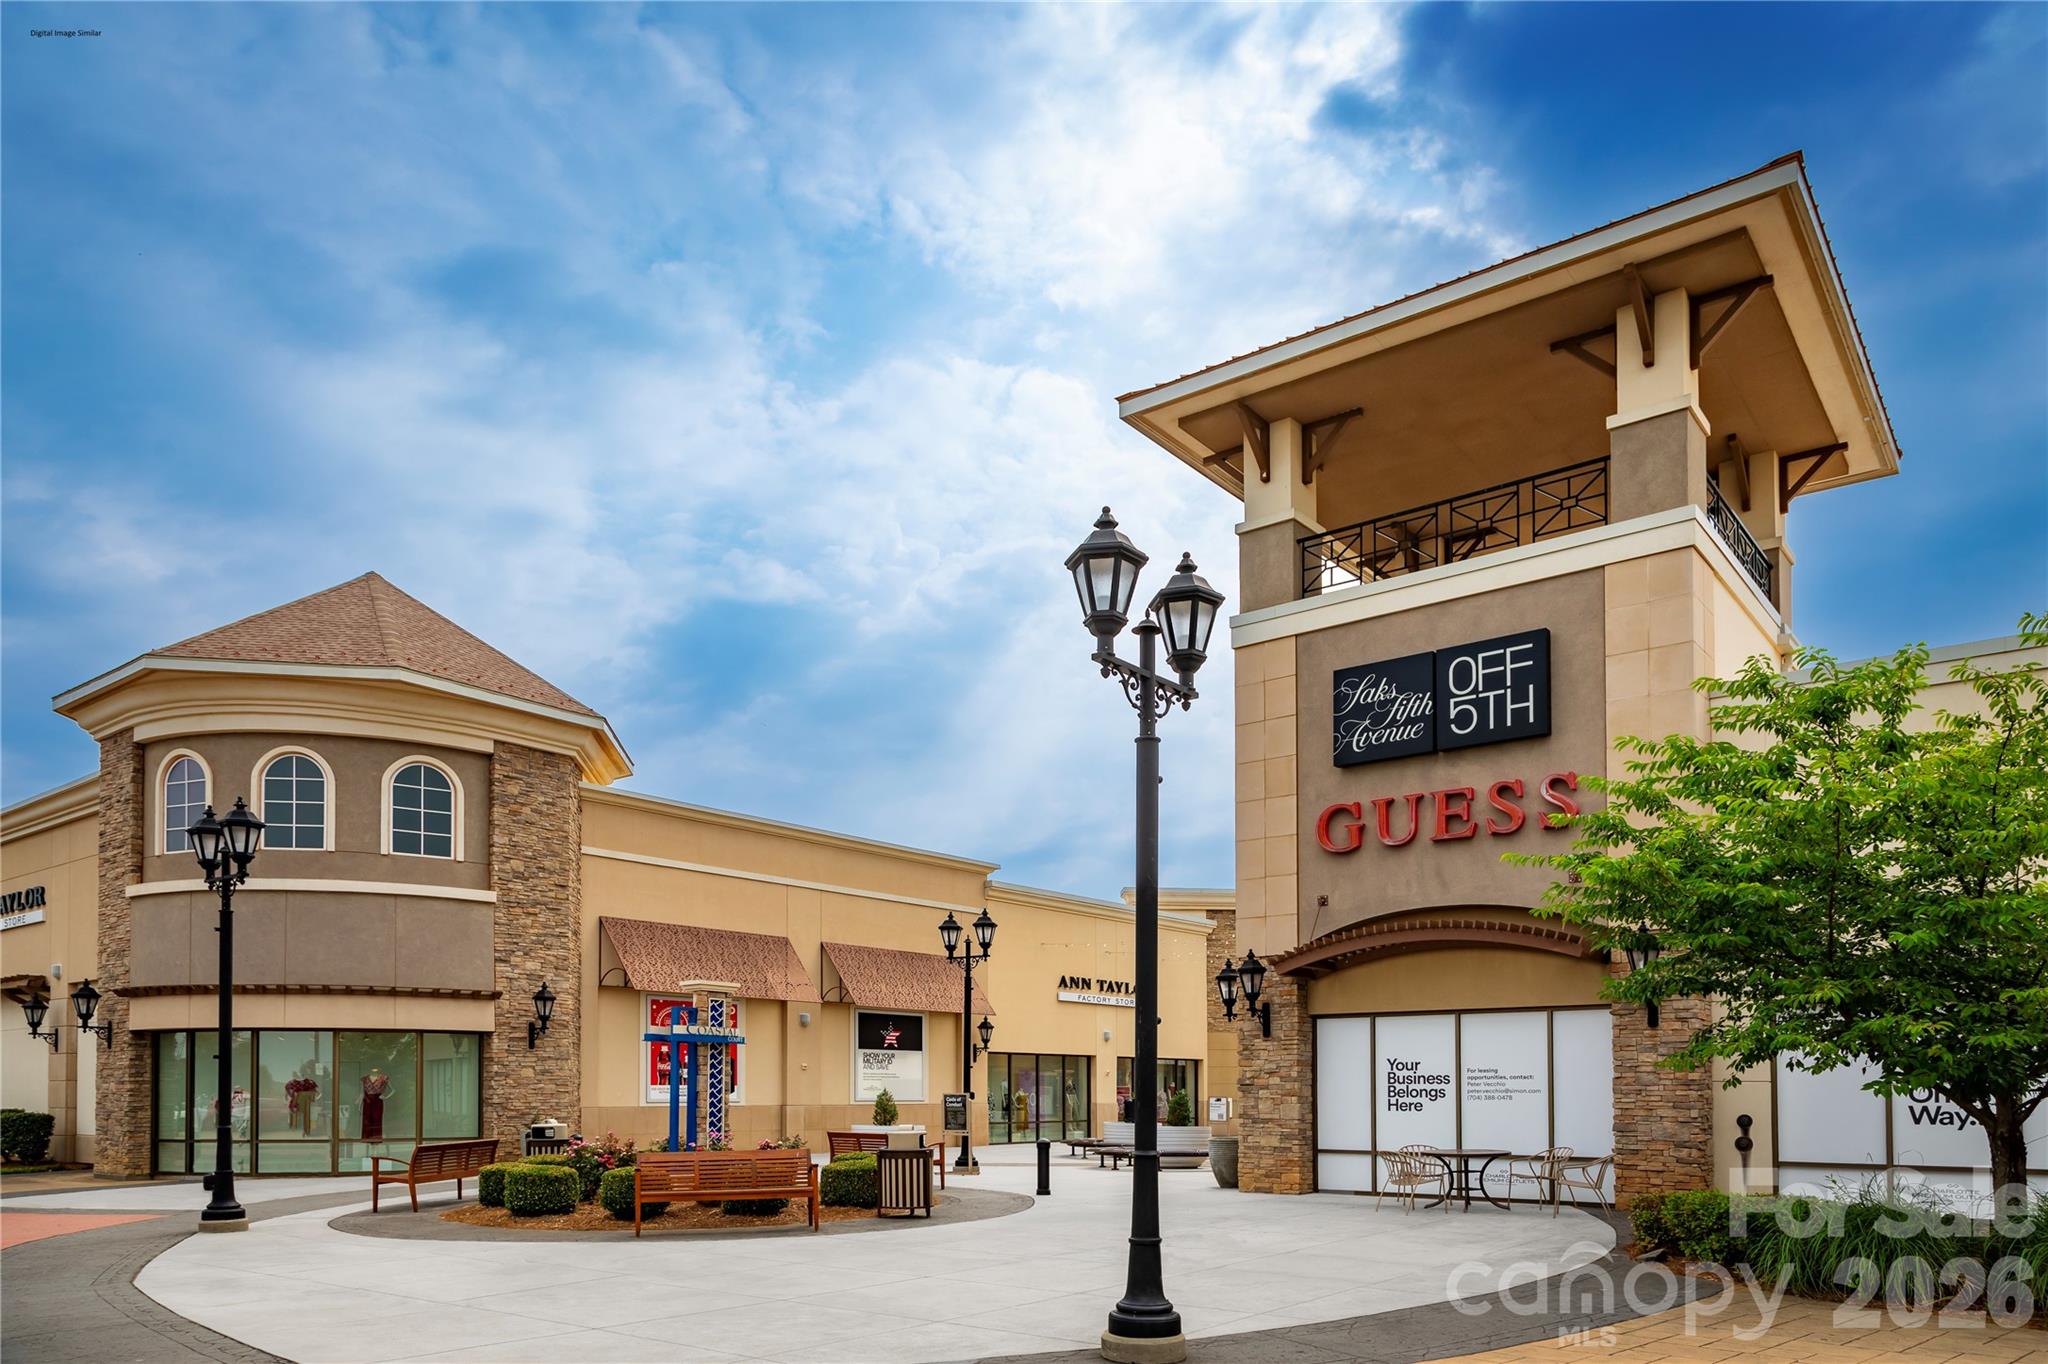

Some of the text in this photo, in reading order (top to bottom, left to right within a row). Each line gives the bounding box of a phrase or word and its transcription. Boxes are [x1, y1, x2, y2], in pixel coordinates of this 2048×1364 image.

[1448, 643, 1533, 695] OFF
[1333, 673, 1397, 716] Saks
[1450, 684, 1534, 735] 5TH
[1333, 719, 1424, 756] Avenue
[1315, 771, 1580, 854] GUESS
[0, 886, 46, 915] AYLOR
[4, 914, 26, 928] STORE
[1058, 975, 1136, 995] ANN TAYL
[1077, 994, 1136, 1006] FACTORY STOR
[686, 1025, 738, 1037] COASTAL
[863, 1051, 880, 1059] SHOW
[1386, 1058, 1421, 1071] Your
[1387, 1071, 1450, 1085] Business
[1387, 1085, 1447, 1101] Belongs
[1387, 1098, 1423, 1112] Here
